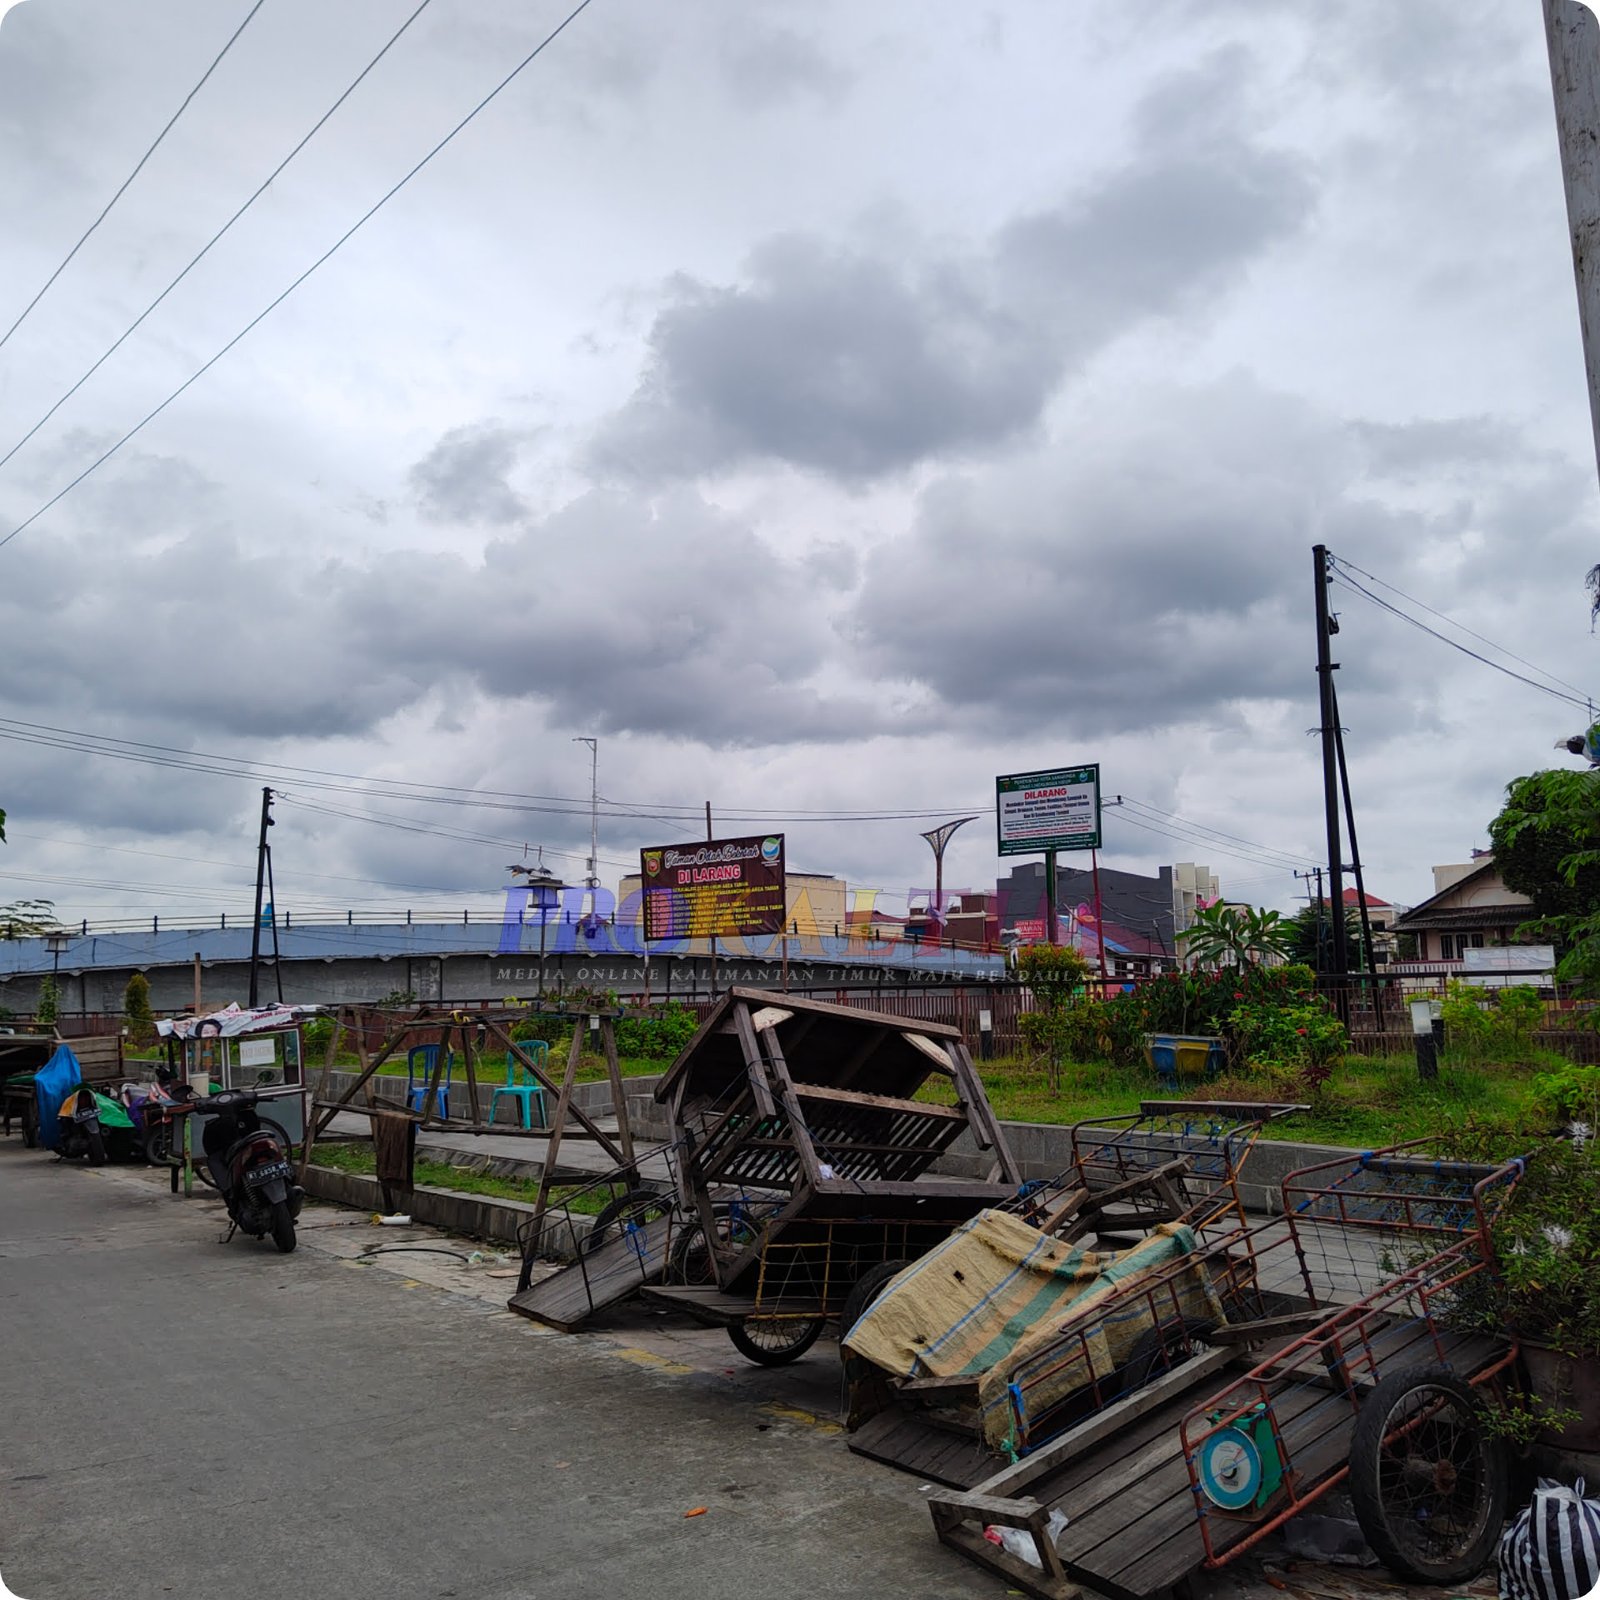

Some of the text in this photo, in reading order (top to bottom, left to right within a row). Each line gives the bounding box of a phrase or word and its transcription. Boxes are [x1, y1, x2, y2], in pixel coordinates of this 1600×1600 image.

[1024, 788, 1067, 800] DILARANG
[664, 850, 696, 869] Taman
[677, 864, 741, 885] DI LARANG
